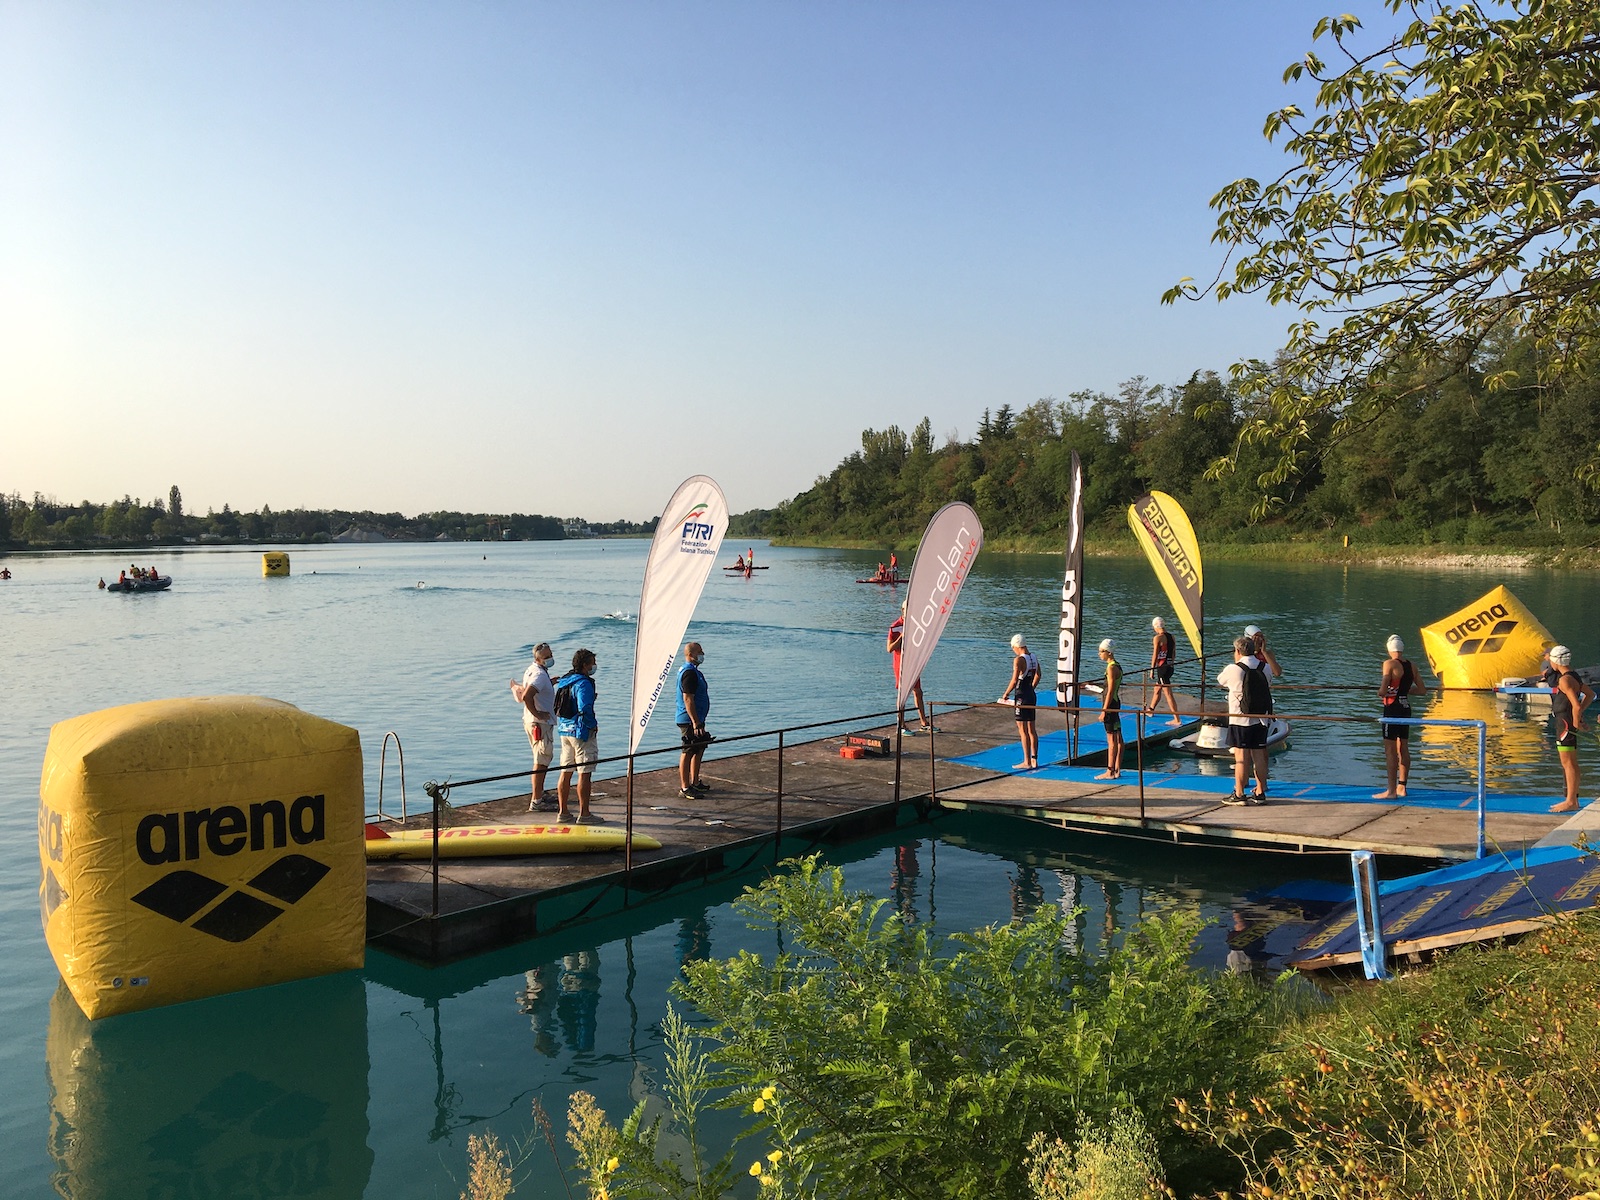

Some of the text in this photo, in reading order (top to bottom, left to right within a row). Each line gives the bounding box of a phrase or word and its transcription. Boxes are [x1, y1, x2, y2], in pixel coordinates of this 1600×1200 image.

[682, 522, 714, 540] FITRI
[910, 526, 970, 647] dorelan
[1445, 603, 1509, 644] arena
[640, 654, 674, 727] Oltre Uno Sport
[136, 794, 326, 866] arena
[419, 827, 571, 840] RESCUE
